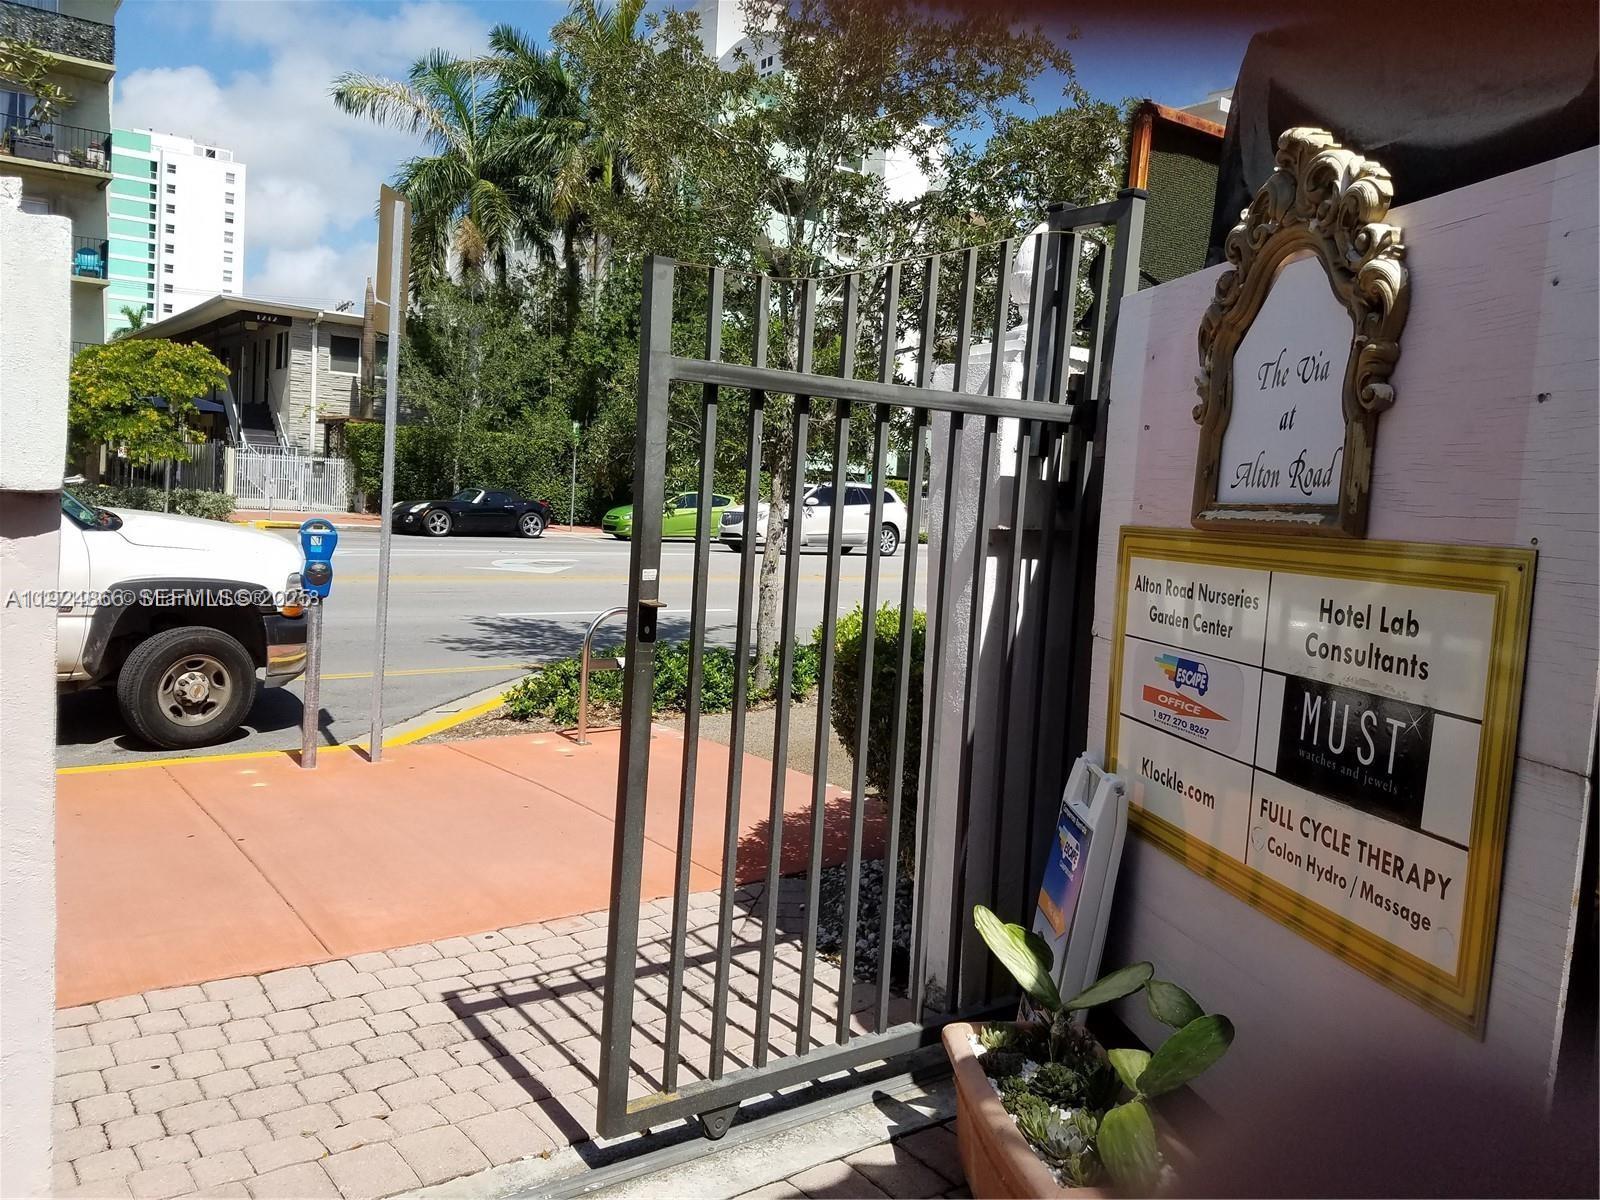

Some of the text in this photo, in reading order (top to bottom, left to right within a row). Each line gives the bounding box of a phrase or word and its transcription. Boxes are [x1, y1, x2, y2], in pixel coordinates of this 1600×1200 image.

[1258, 348, 1331, 391] The Via
[1279, 404, 1297, 431] at
[1231, 447, 1343, 496] Alton Road
[1134, 574, 1260, 610] Alton Road Nurseries
[1149, 605, 1234, 639] Garden Center
[1319, 598, 1420, 638] Hotel Lab
[1305, 632, 1430, 681] Consultants
[1176, 667, 1207, 690] ESCAPE
[1158, 694, 1201, 715] OFFICE
[1158, 711, 1172, 723] 877
[1172, 717, 1188, 729] 270
[1189, 723, 1210, 736] 8267
[1300, 691, 1407, 775] MUST
[1141, 756, 1215, 810] Klockle.com
[1298, 748, 1399, 796] watches and jewels
[1259, 797, 1452, 900] FULL CYCLE THERAPY
[1267, 836, 1432, 931] Colon Hydro / Massage
